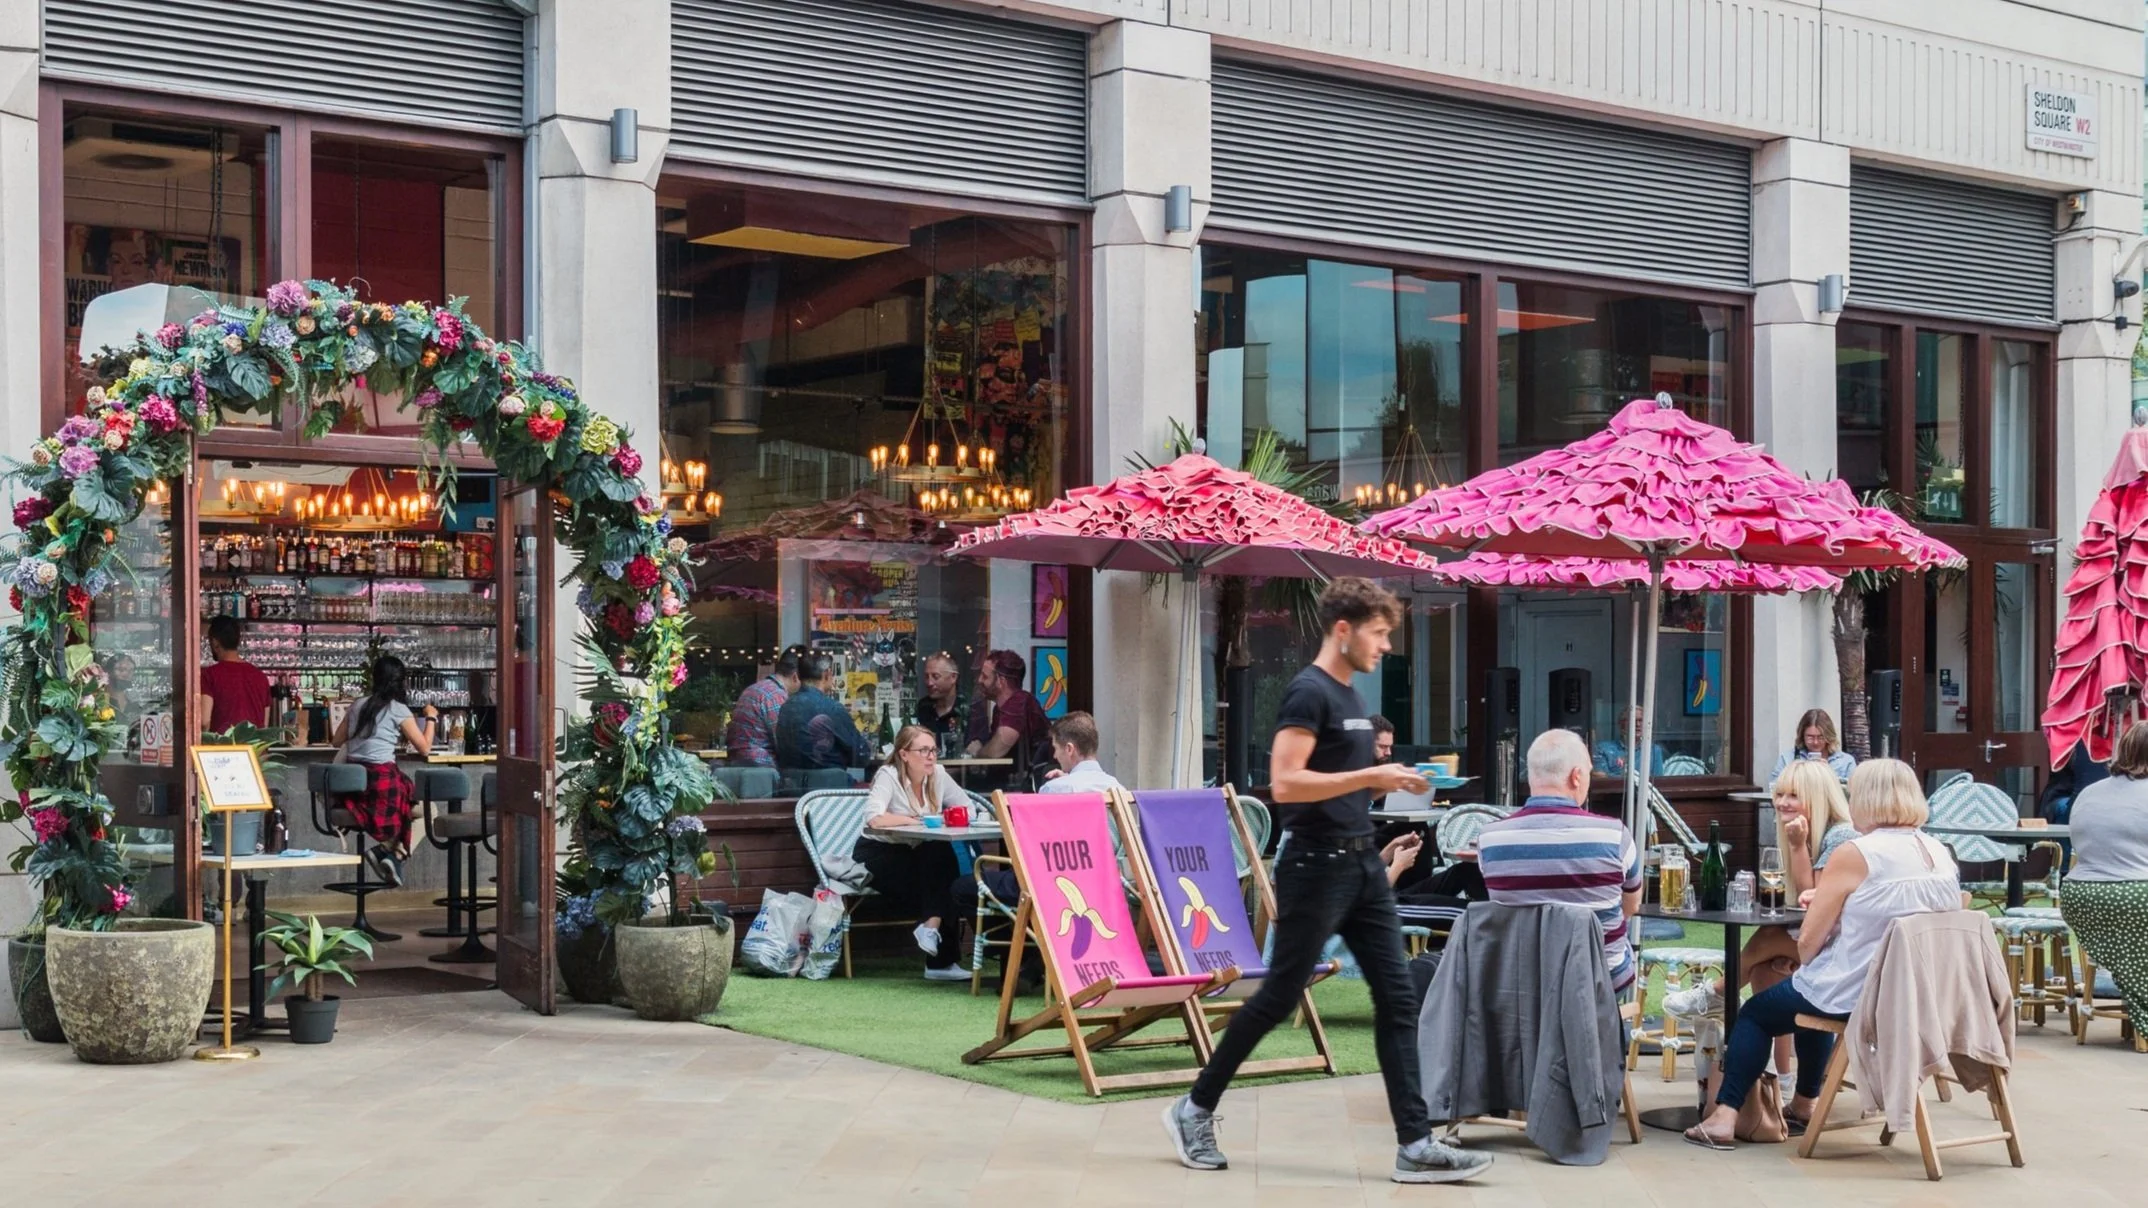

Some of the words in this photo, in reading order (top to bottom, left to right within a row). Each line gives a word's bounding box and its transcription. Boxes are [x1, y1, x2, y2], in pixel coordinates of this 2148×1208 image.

[2034, 91, 2076, 114] SHELDON
[2034, 110, 2072, 132] SQUARE
[2076, 117, 2091, 136] W2
[1040, 840, 1093, 872] YOUR
[1164, 845, 1209, 873] YOUR
